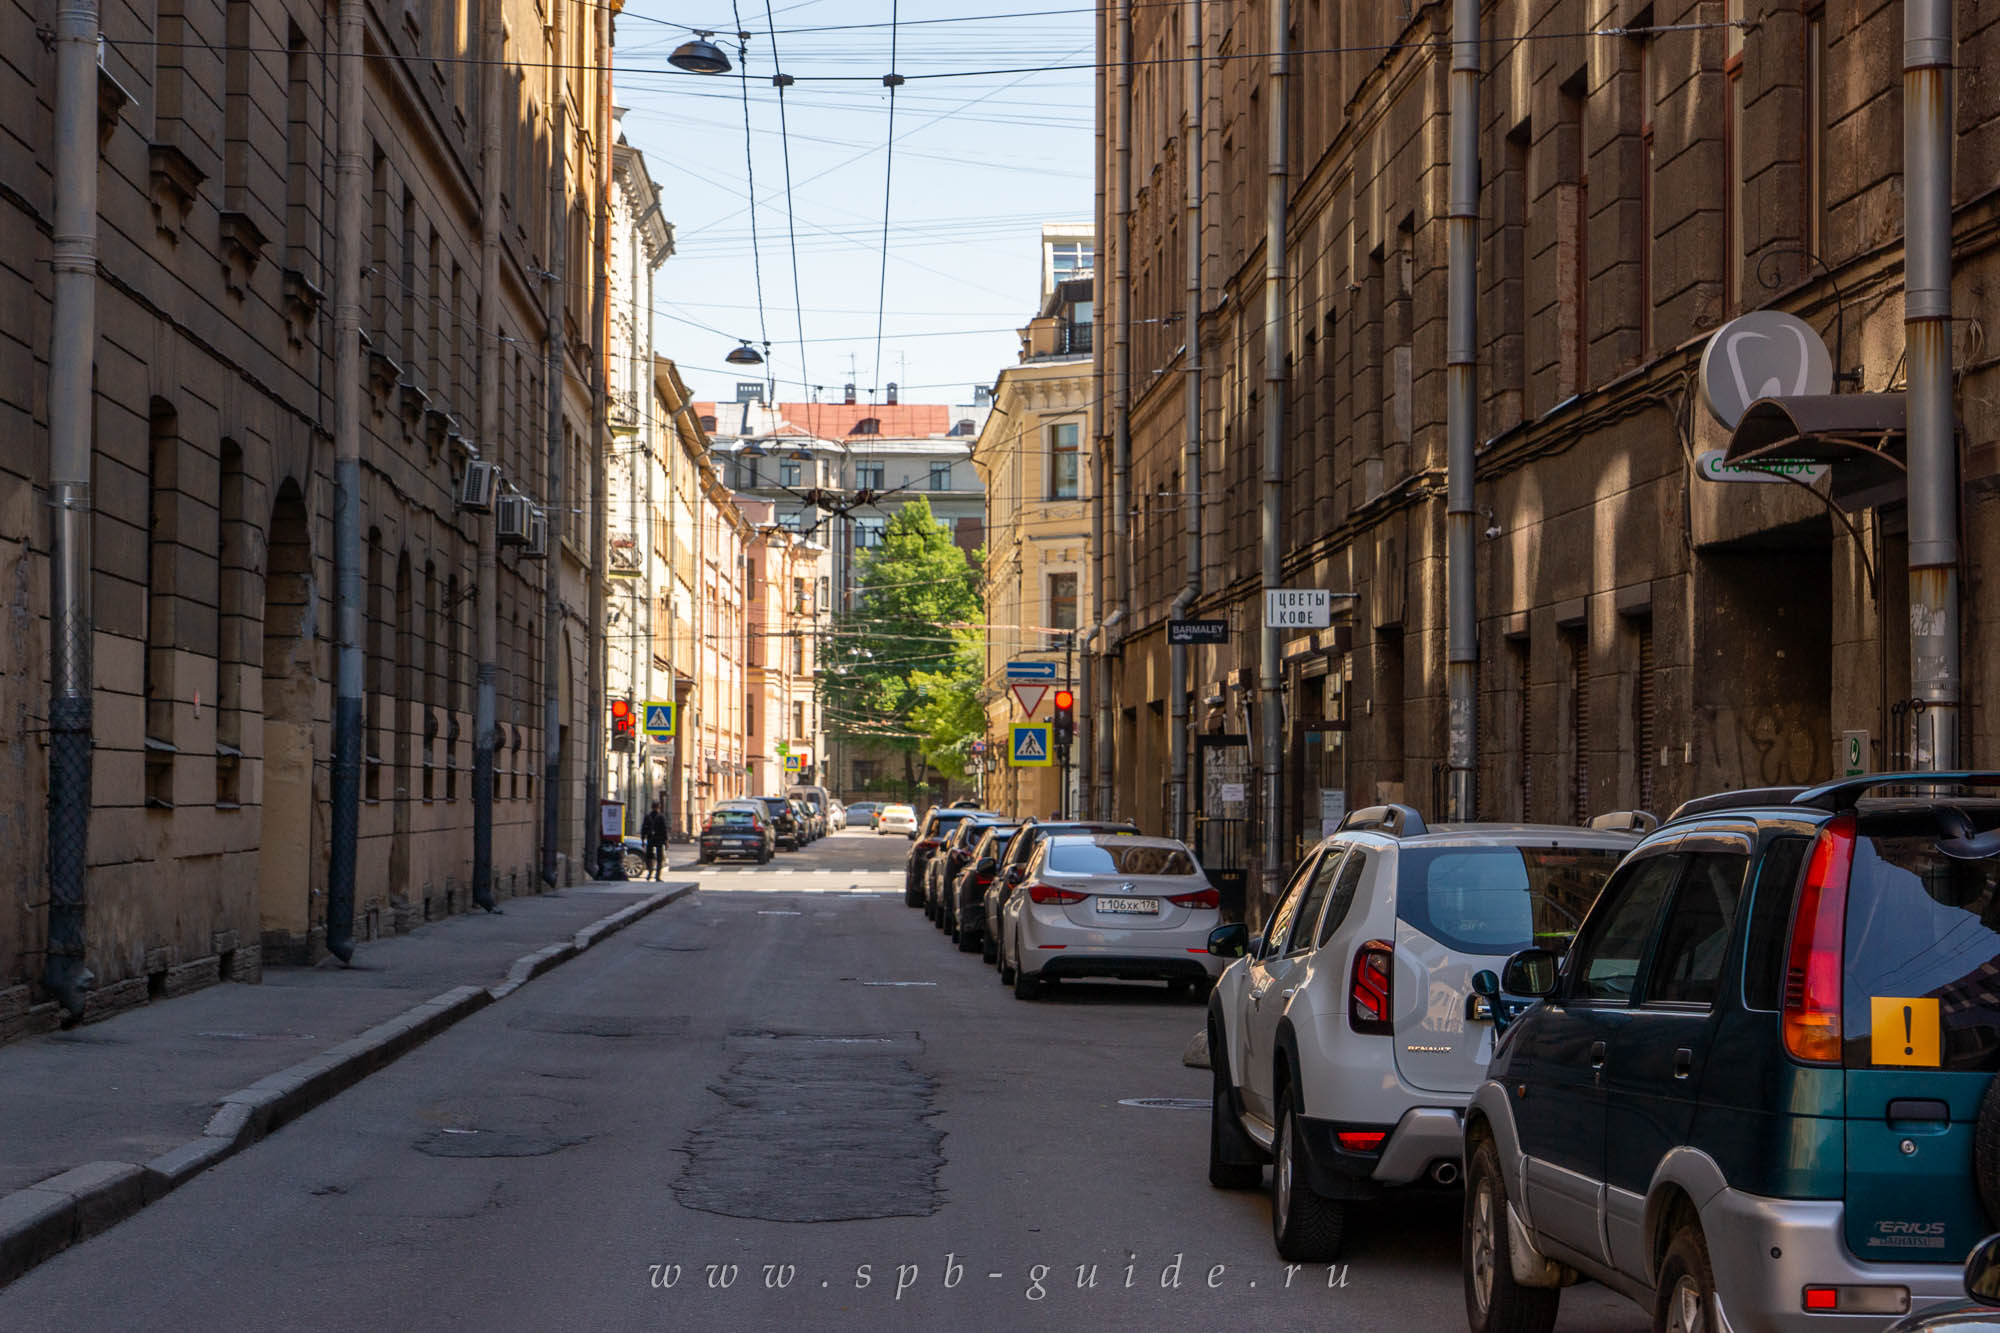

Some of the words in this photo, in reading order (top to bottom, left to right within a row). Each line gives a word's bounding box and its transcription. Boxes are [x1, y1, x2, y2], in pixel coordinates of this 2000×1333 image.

[1279, 592, 1325, 608] ЦВЕТЫ
[1279, 611, 1313, 624] КОФЕ
[1172, 624, 1224, 634] BARMALEY
[1407, 1045, 1452, 1053] RENAULT
